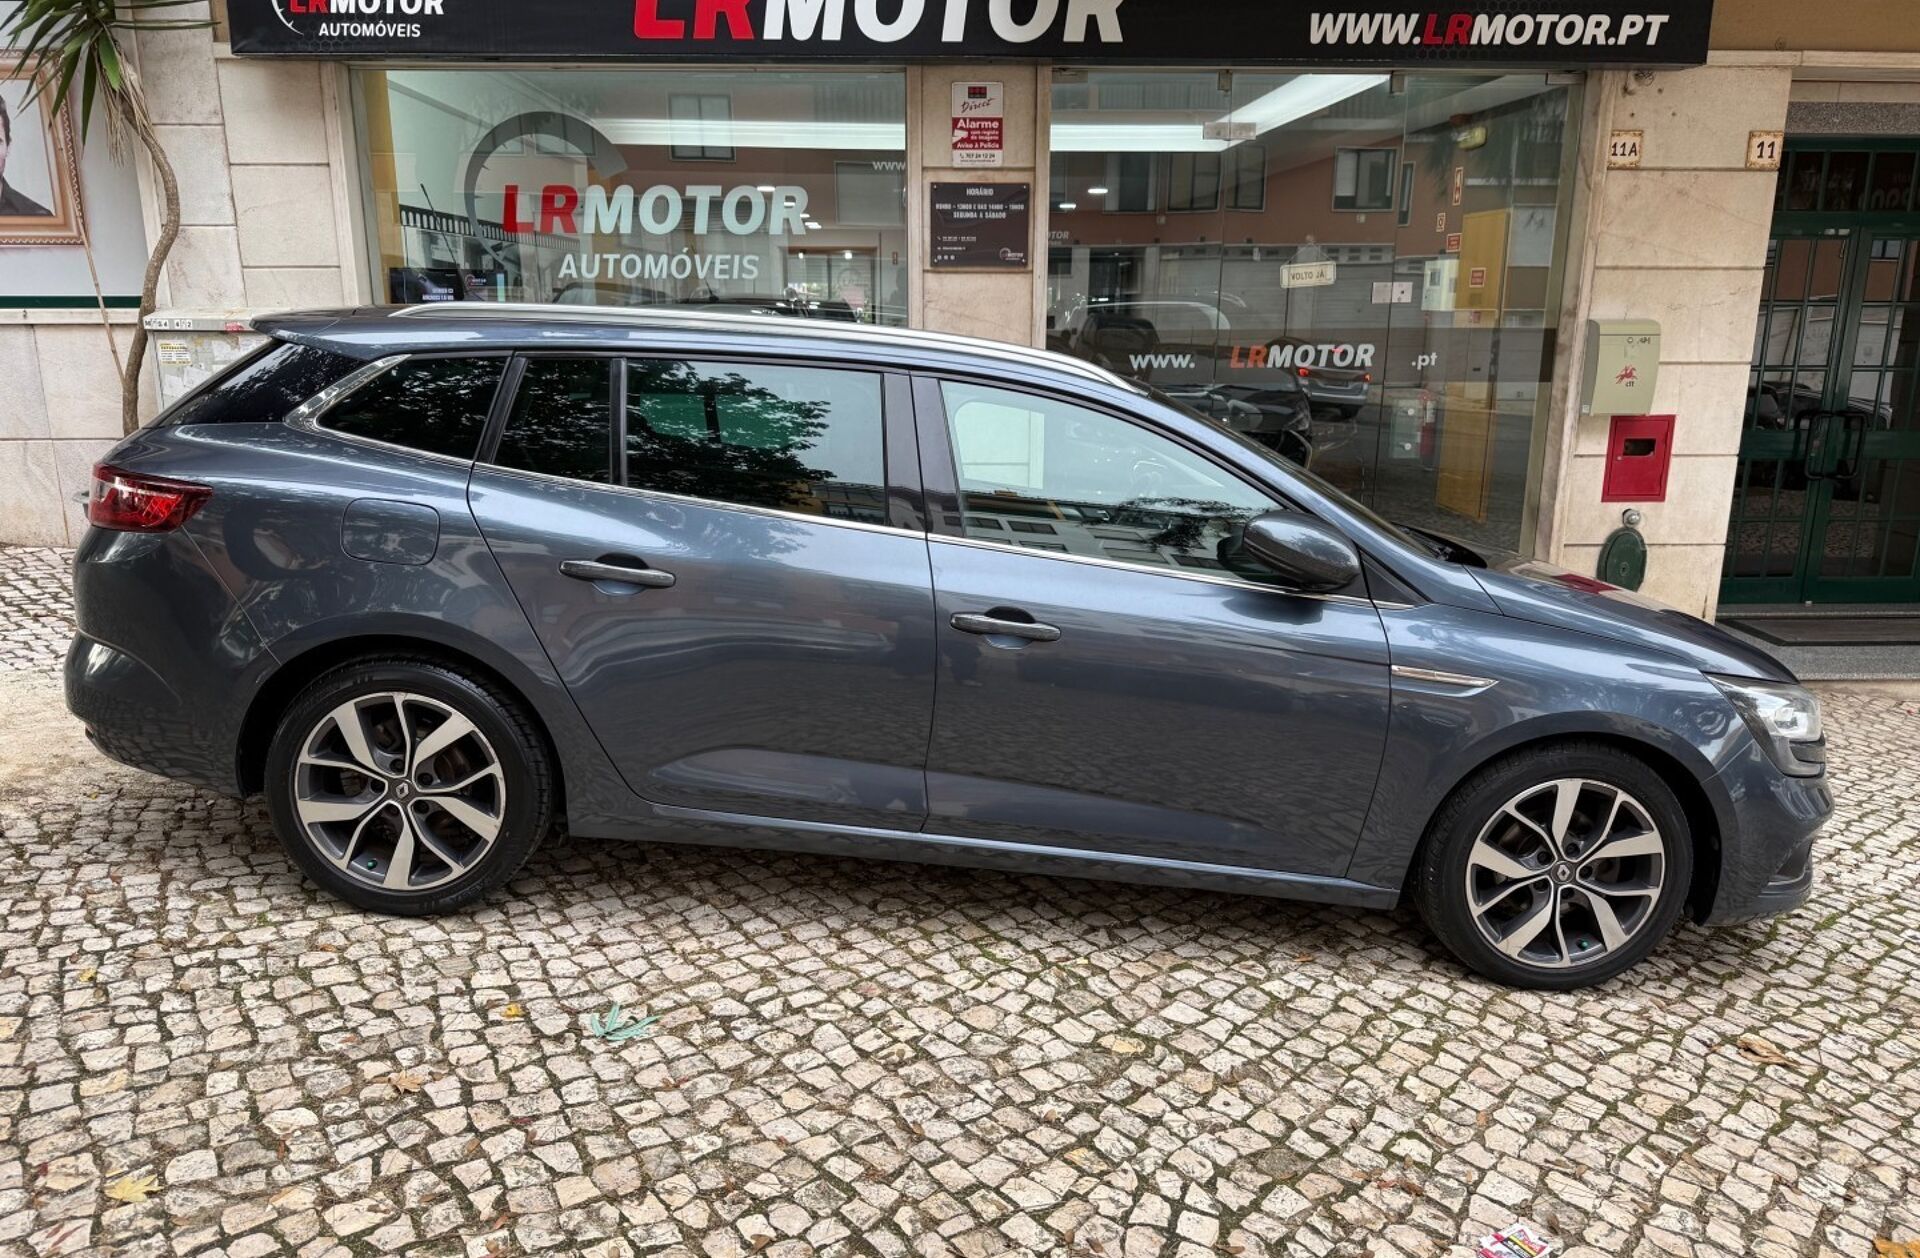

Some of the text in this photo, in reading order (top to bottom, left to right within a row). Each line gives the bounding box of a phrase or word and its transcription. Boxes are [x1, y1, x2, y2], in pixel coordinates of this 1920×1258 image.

[319, 20, 421, 38] AUTOMÓVEIS
[1309, 12, 1670, 46] WWW.LRMOTOR.PT
[956, 118, 1000, 129] Alarme
[1611, 142, 1638, 157] 11A
[1756, 140, 1776, 159] 11
[966, 187, 994, 197] HORÁRIO
[503, 184, 809, 235] LRMOTOR
[953, 211, 978, 219] SEGUNDA
[984, 210, 1007, 219] SÁBADO
[558, 247, 760, 280] AUTOMÓVEIS
[1290, 268, 1325, 281] VOLTO JÁ
[1129, 343, 1438, 370] www. LRMOTOR .pt
